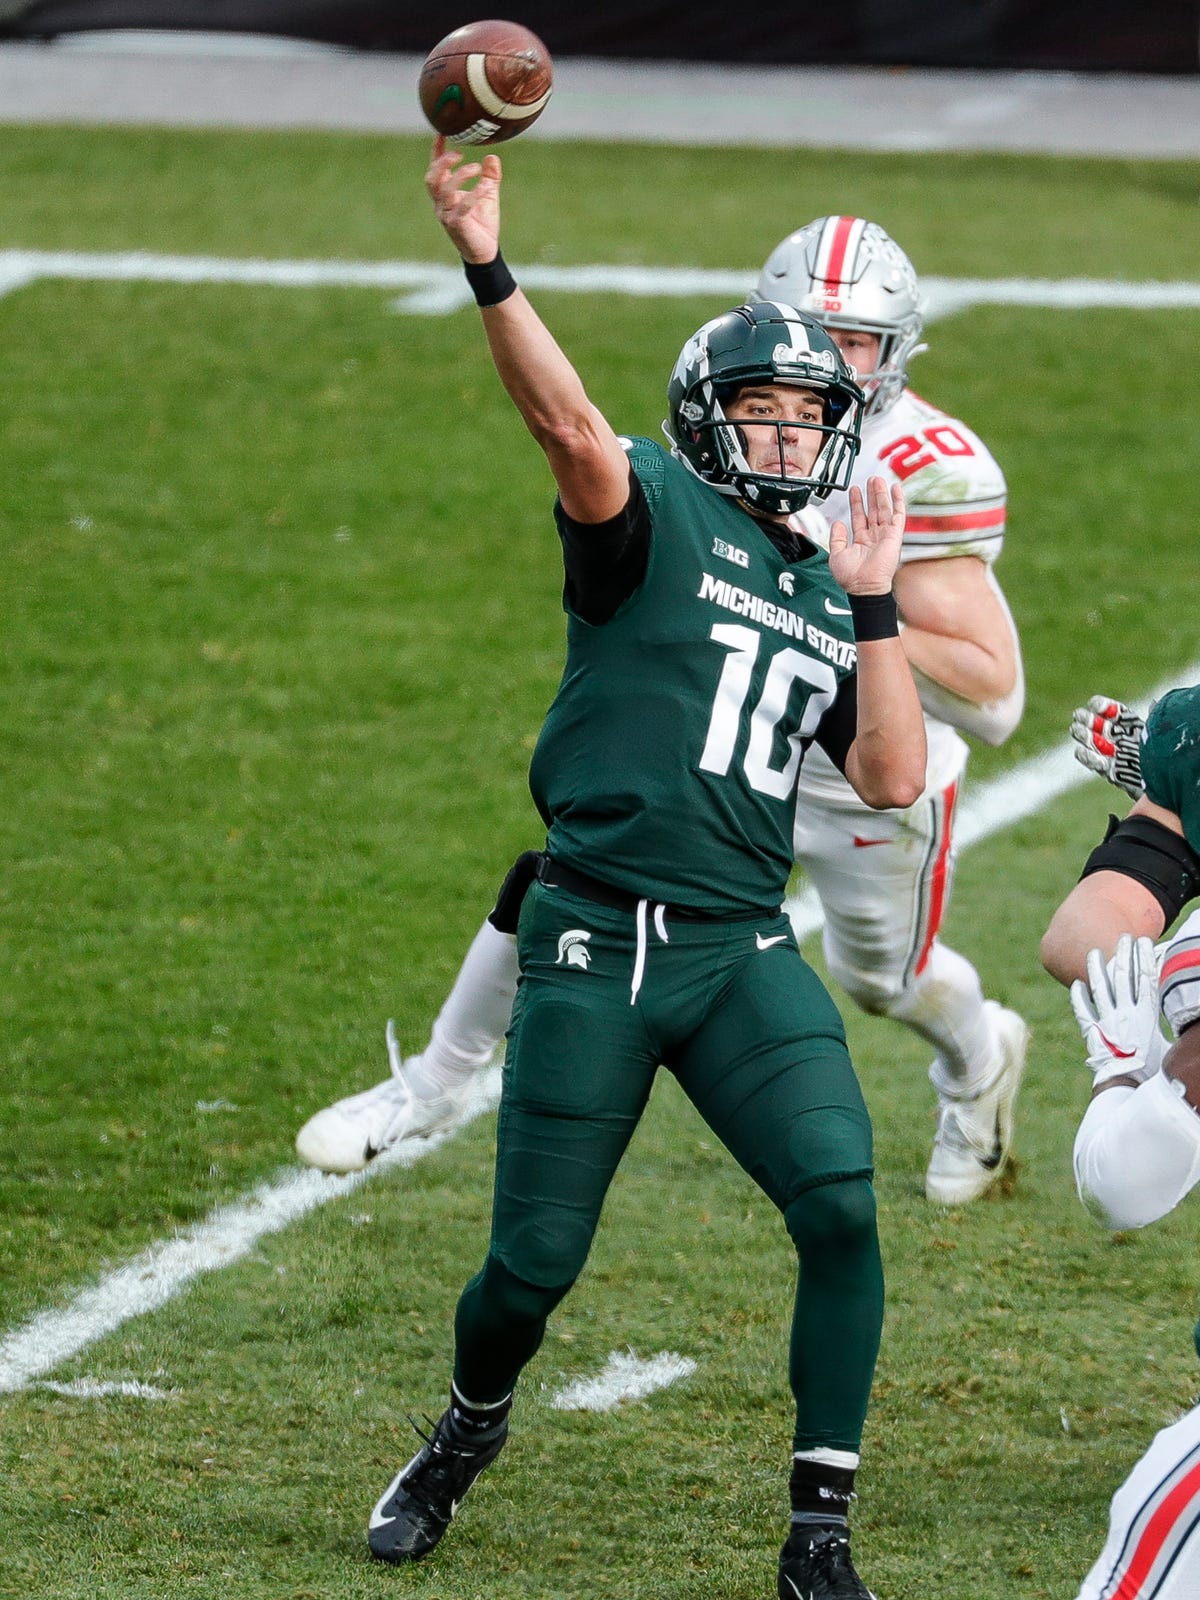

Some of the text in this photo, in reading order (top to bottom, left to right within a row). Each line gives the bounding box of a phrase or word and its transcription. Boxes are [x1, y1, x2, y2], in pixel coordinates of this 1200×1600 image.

[878, 425, 975, 481] 20
[697, 572, 804, 640] MICHIGAN
[699, 623, 838, 801] 10
